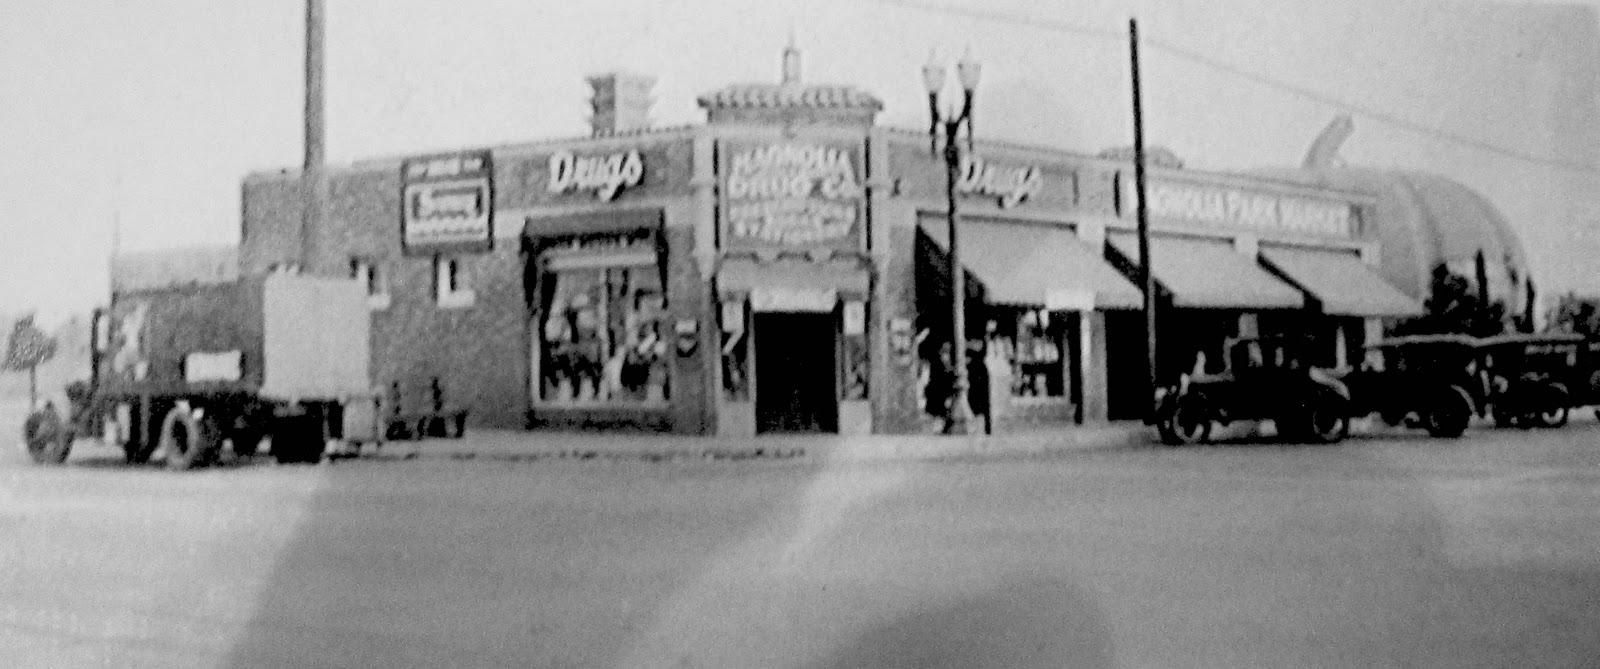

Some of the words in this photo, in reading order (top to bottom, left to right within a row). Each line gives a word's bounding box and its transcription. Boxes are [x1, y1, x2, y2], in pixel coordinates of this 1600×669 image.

[547, 150, 643, 202] Drugs
[727, 174, 812, 200] DRUG
[957, 156, 1042, 208] Drugs
[1226, 191, 1278, 226] PARK
[1281, 198, 1348, 236] MARKET
